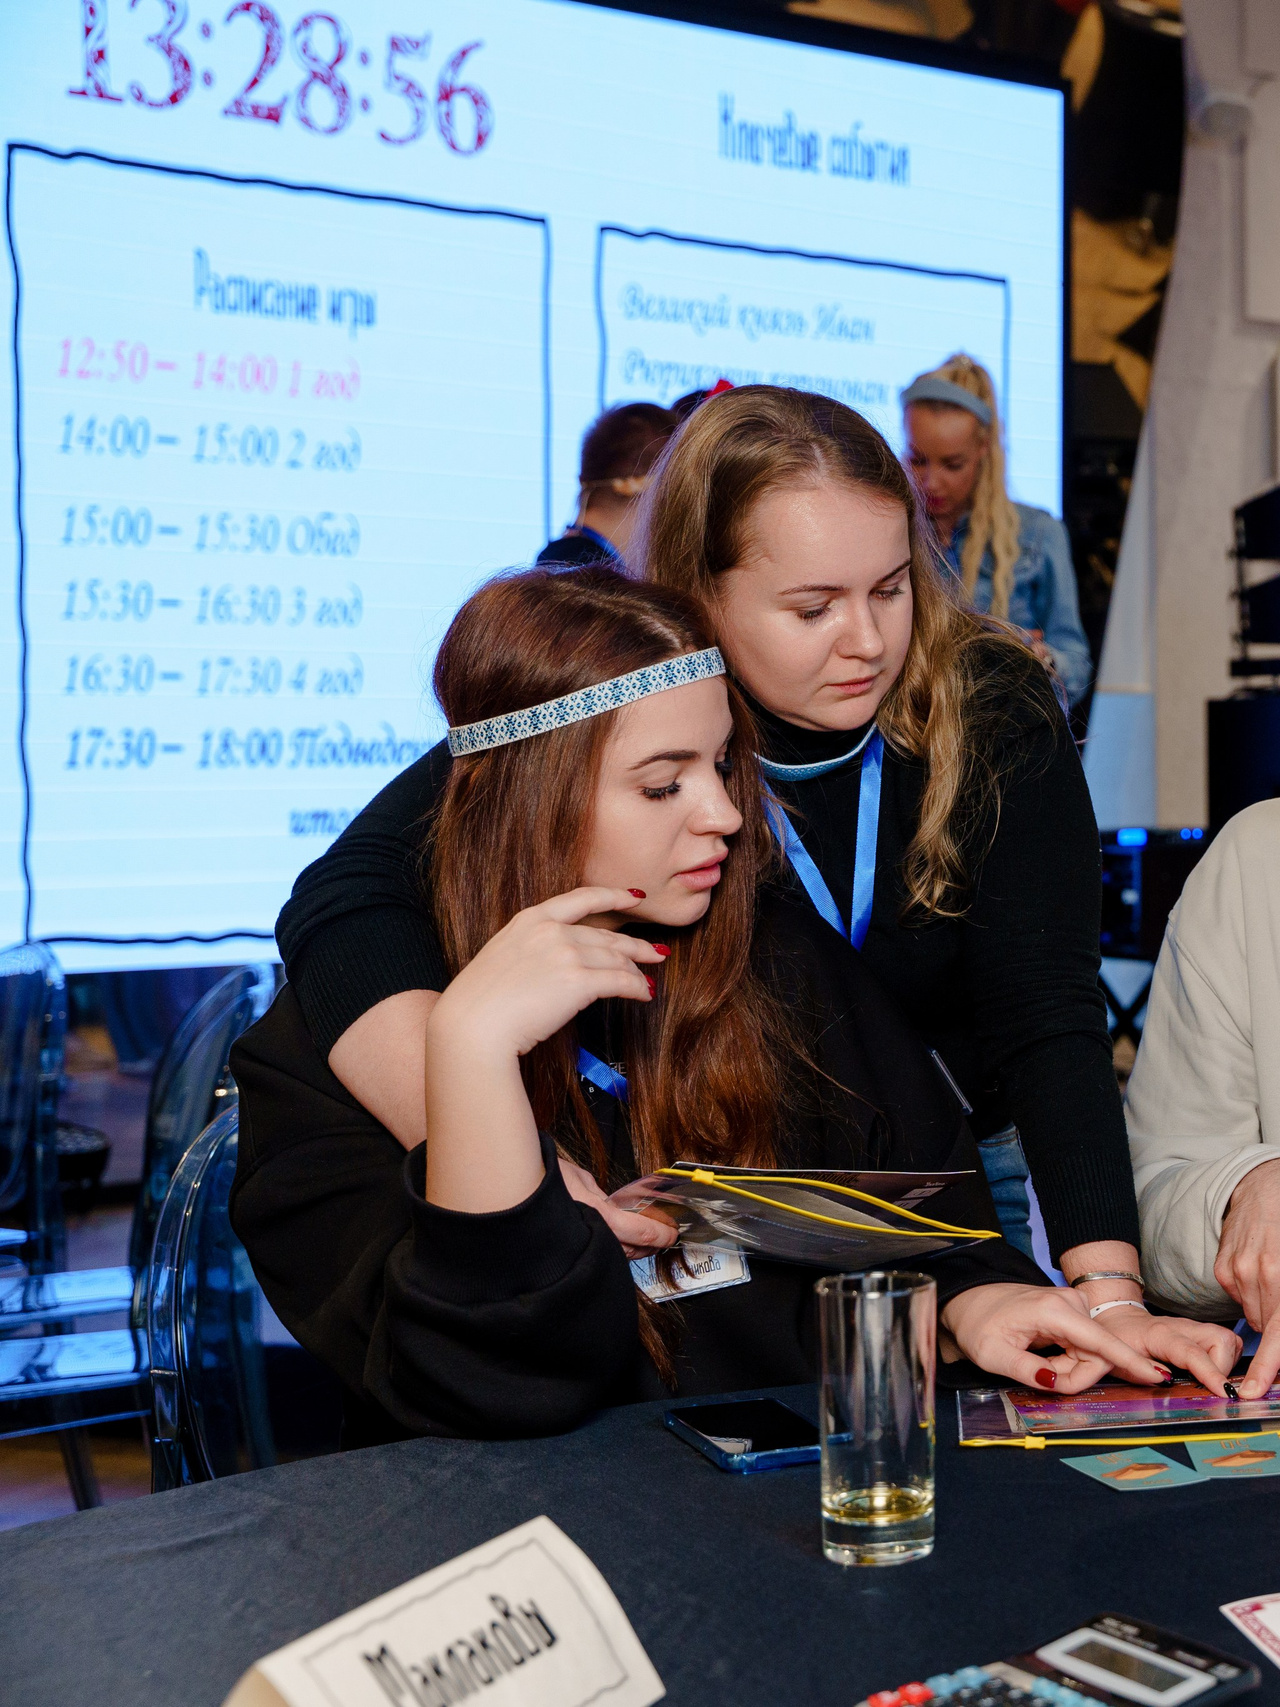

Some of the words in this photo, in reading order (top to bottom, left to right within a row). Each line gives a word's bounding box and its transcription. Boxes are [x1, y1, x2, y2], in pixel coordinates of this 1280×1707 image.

[66, 0, 494, 157] 13:28:56
[828, 121, 911, 187] события
[194, 247, 321, 327] Расписание
[327, 285, 378, 338] игры
[619, 282, 731, 336] Великий
[193, 350, 278, 393] 14:00
[287, 360, 301, 398] 1
[312, 356, 361, 401] год
[192, 422, 279, 467] 15:00
[286, 429, 307, 470] 2
[312, 427, 362, 472] год
[194, 512, 281, 555] 15:30
[286, 511, 361, 557] Обед
[195, 584, 282, 626] 16:30
[287, 585, 307, 625] 3
[314, 582, 364, 628] год
[196, 657, 283, 697] 17:30
[287, 659, 308, 696] 4
[316, 652, 364, 697] год
[197, 729, 283, 768] 18:00
[286, 720, 436, 768] Подведен
[289, 807, 356, 836] ито
